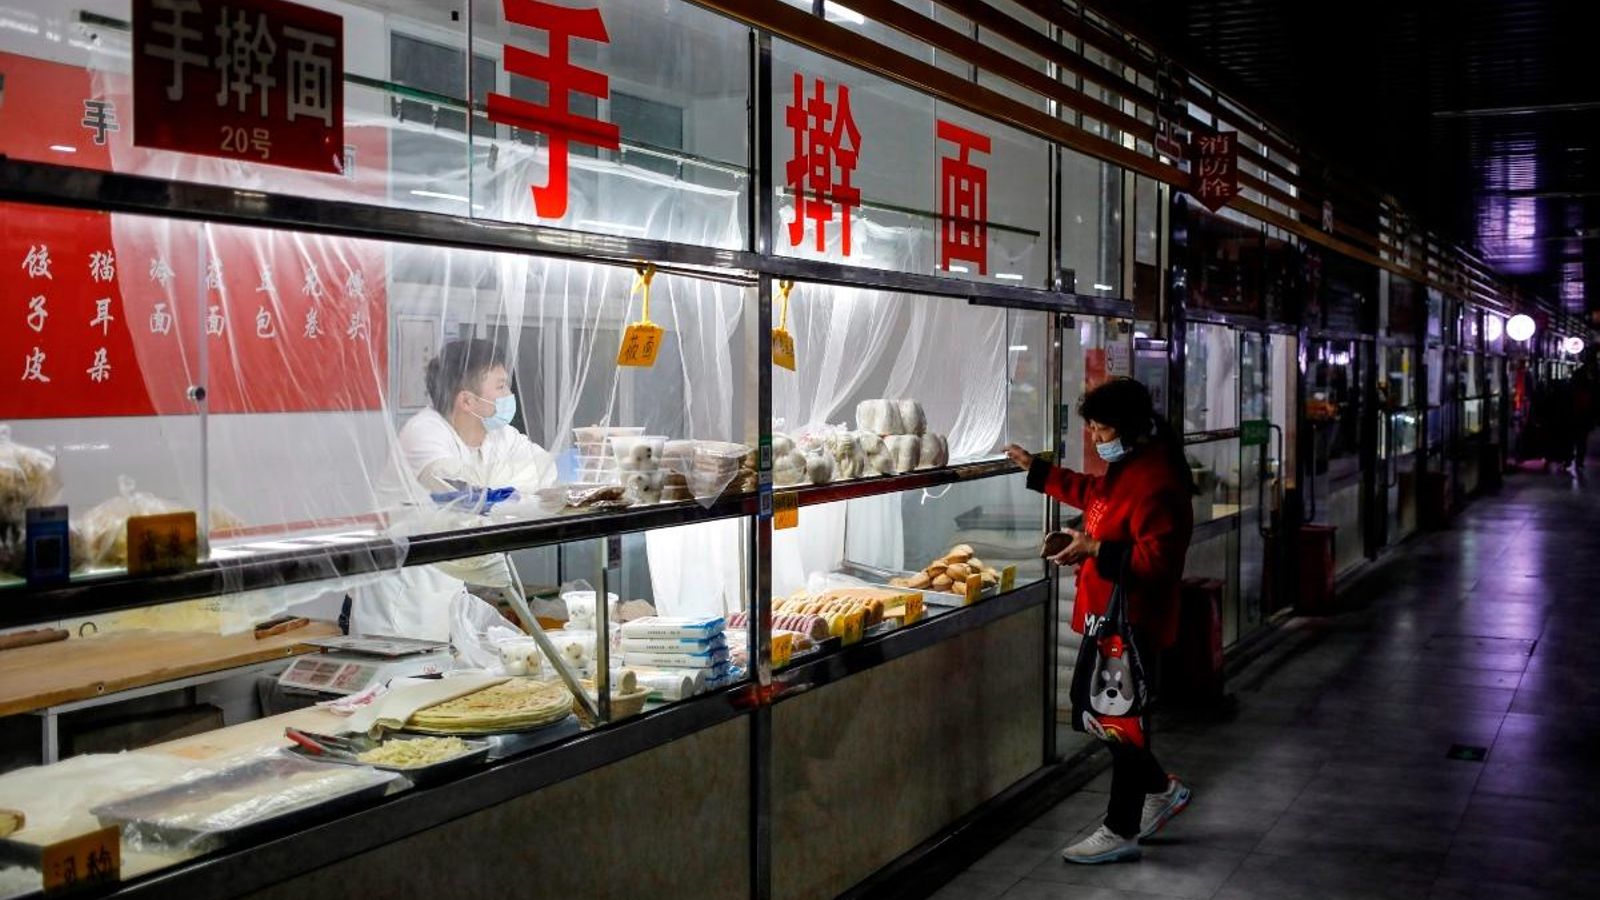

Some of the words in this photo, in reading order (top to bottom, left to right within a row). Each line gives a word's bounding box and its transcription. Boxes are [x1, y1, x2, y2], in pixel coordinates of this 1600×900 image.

[143, 0, 336, 128] 手擀面
[219, 125, 272, 160] 20号
[487, 0, 991, 275] 手擀面
[1197, 135, 1231, 198] 消防栓
[21, 243, 53, 383] 饺子皮
[86, 249, 117, 383] 猫耳朵
[149, 257, 175, 336] 冷面
